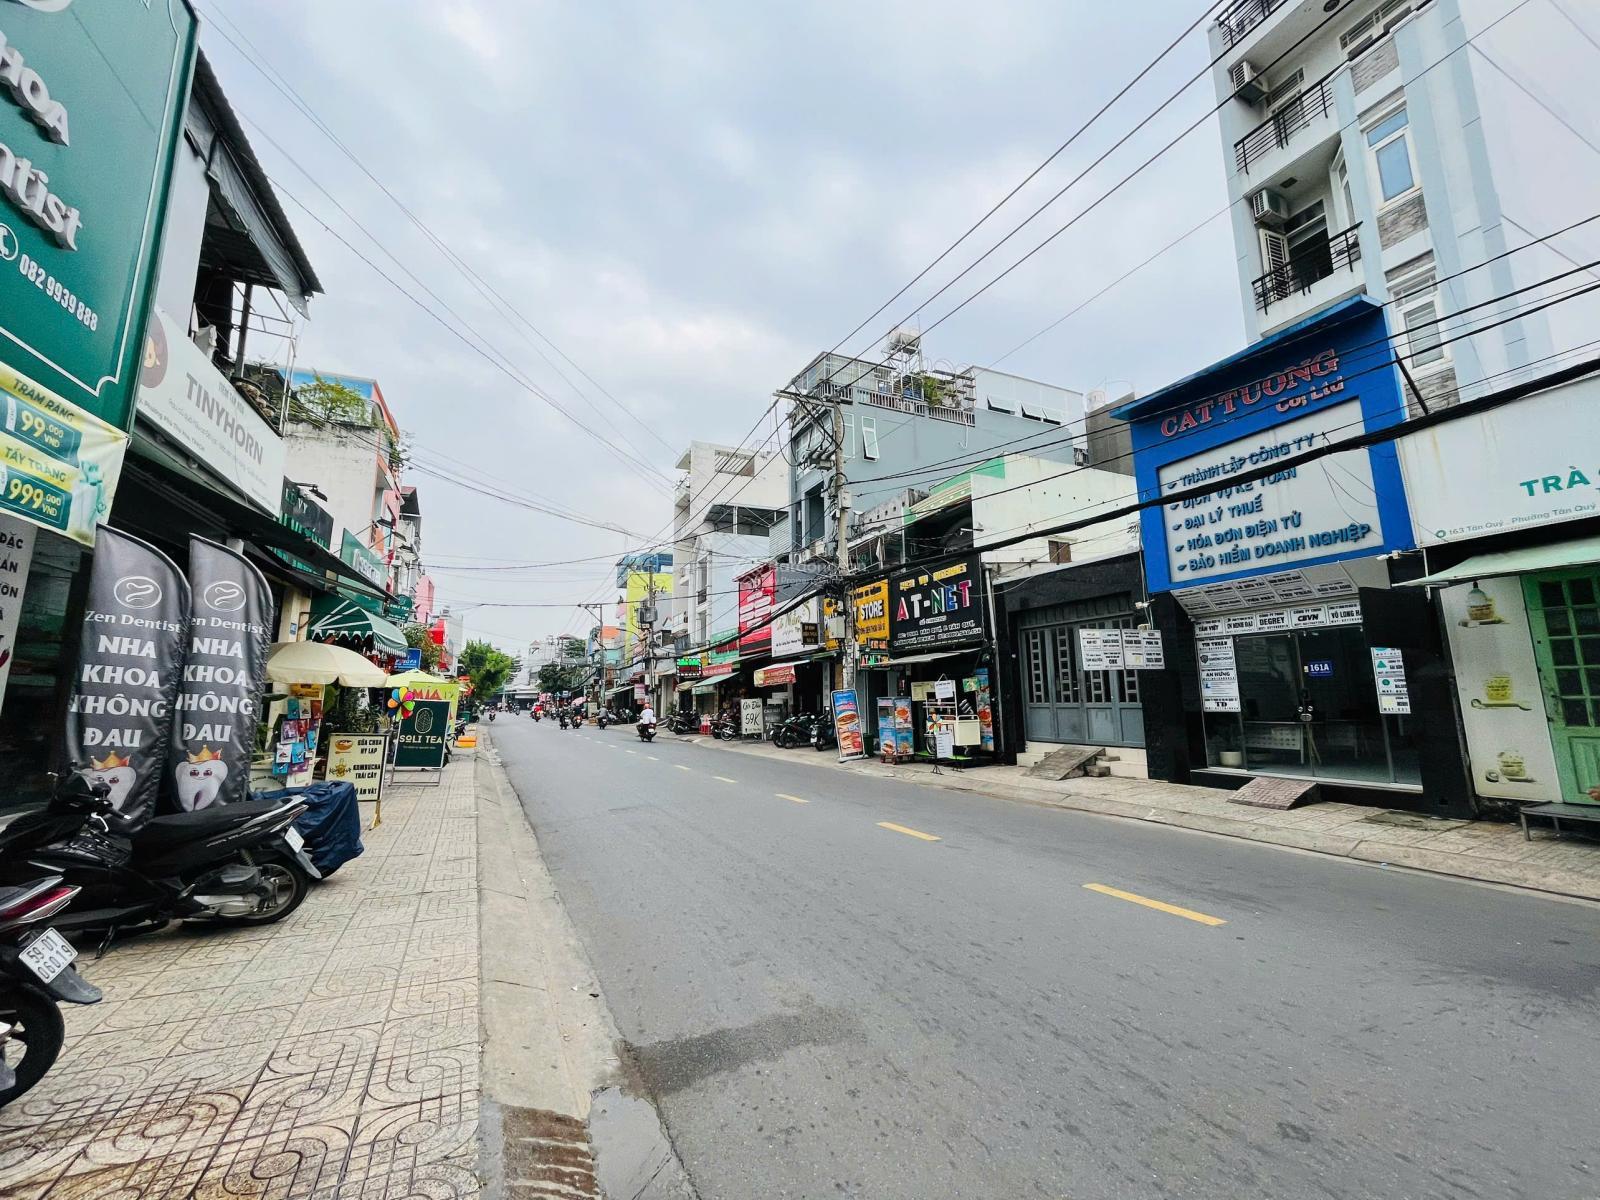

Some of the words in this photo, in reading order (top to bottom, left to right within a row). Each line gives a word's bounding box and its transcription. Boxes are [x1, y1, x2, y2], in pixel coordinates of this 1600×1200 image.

[19, 254, 46, 289] 082
[46, 276, 77, 313] 9939
[76, 301, 98, 331] 888
[186, 373, 263, 465] TINYHORN
[43, 433, 60, 448] VND
[1248, 442, 1291, 465] CÔNG
[1519, 465, 1591, 497] TRÀ
[42, 503, 58, 517] VND
[1184, 514, 1204, 530] ĐẠI
[1208, 506, 1223, 524] LÝ
[1227, 493, 1263, 519] THUẾ
[1187, 535, 1212, 552] HÓA
[1214, 528, 1243, 545] ĐƠN
[1245, 519, 1278, 538] ĐIỆN
[1280, 510, 1303, 529] TỬ
[1188, 552, 1215, 571] BẢO
[1218, 544, 1251, 565] HIỂM
[1255, 536, 1306, 559] DOANH
[1308, 522, 1372, 549] NGHIỆP
[860, 599, 883, 620] STORE
[896, 579, 972, 621] AT-NET
[85, 610, 116, 624] Zen
[120, 613, 181, 633] Dentist
[191, 617, 207, 627] en
[211, 616, 265, 634] Dentist
[1259, 616, 1285, 626] DEGREY
[1297, 613, 1319, 622] CBVN
[97, 634, 157, 659] NHA
[192, 636, 243, 659] NHA
[81, 664, 161, 688] KHOA
[183, 665, 248, 688] KHOA
[1310, 663, 1329, 672] 161A
[745, 712, 761, 726] 59K
[83, 727, 142, 748] ĐAU
[182, 723, 233, 743] ĐAU
[399, 735, 422, 743] SOLI
[425, 735, 443, 744] TEA
